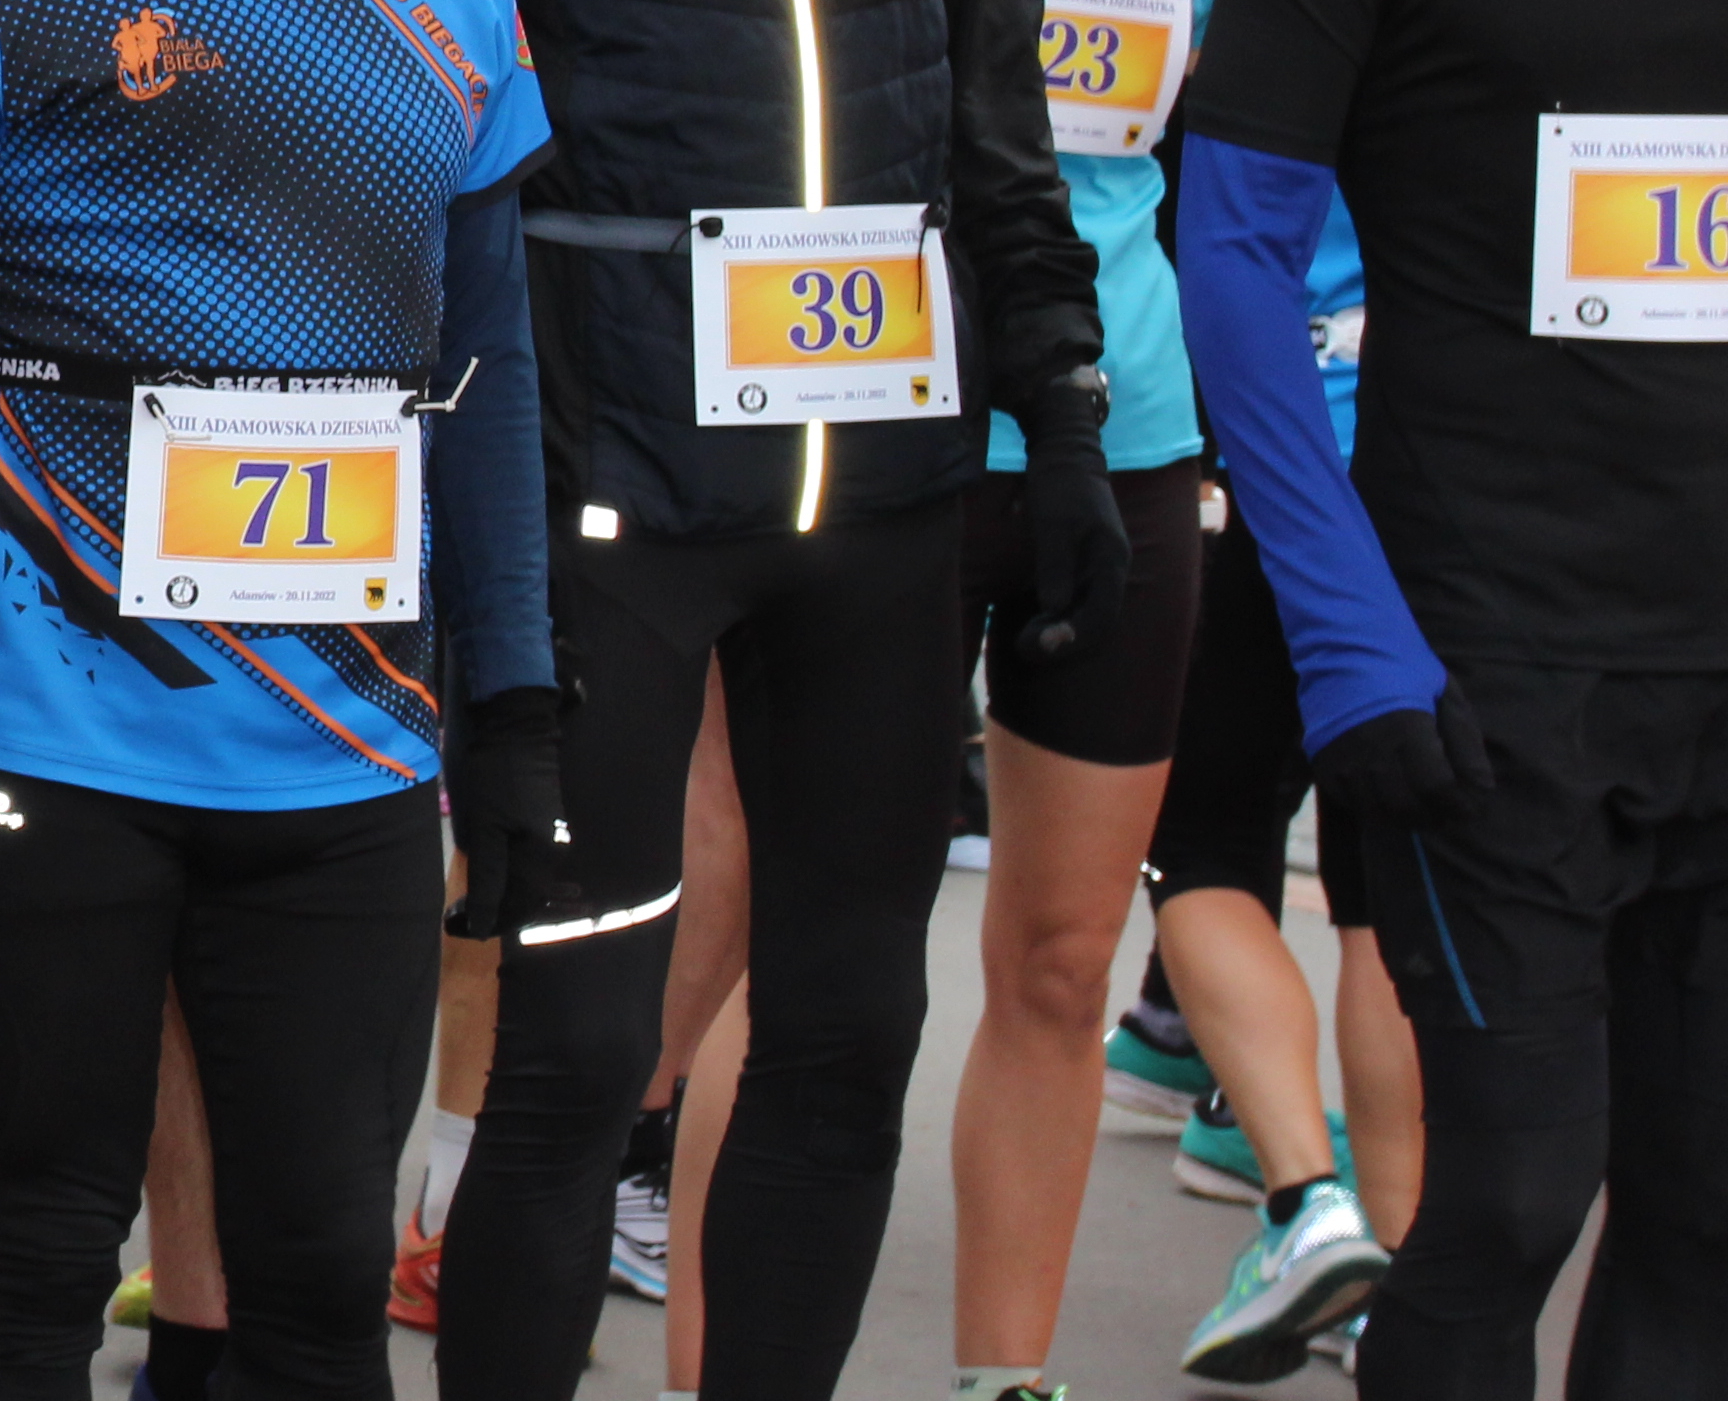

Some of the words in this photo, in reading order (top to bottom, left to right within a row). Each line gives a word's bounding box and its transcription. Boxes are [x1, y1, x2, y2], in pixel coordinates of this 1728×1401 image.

[162, 50, 224, 74] BIEGA
[1041, 20, 1120, 96] 23
[1570, 141, 1602, 158] XIII
[1606, 141, 1718, 159] ADAMOWSKA
[722, 234, 753, 250] XIII
[756, 231, 859, 250] ADAMOWSKA
[860, 228, 921, 247] DZIESIĄTK
[789, 268, 884, 353] 39
[165, 414, 198, 433] XIII
[202, 416, 318, 436] ADAMOWSKA
[320, 418, 403, 439] DZIESIĄTKA
[232, 459, 334, 548] 71
[230, 588, 276, 601] Adamów
[285, 589, 336, 602] 20.11.2022
